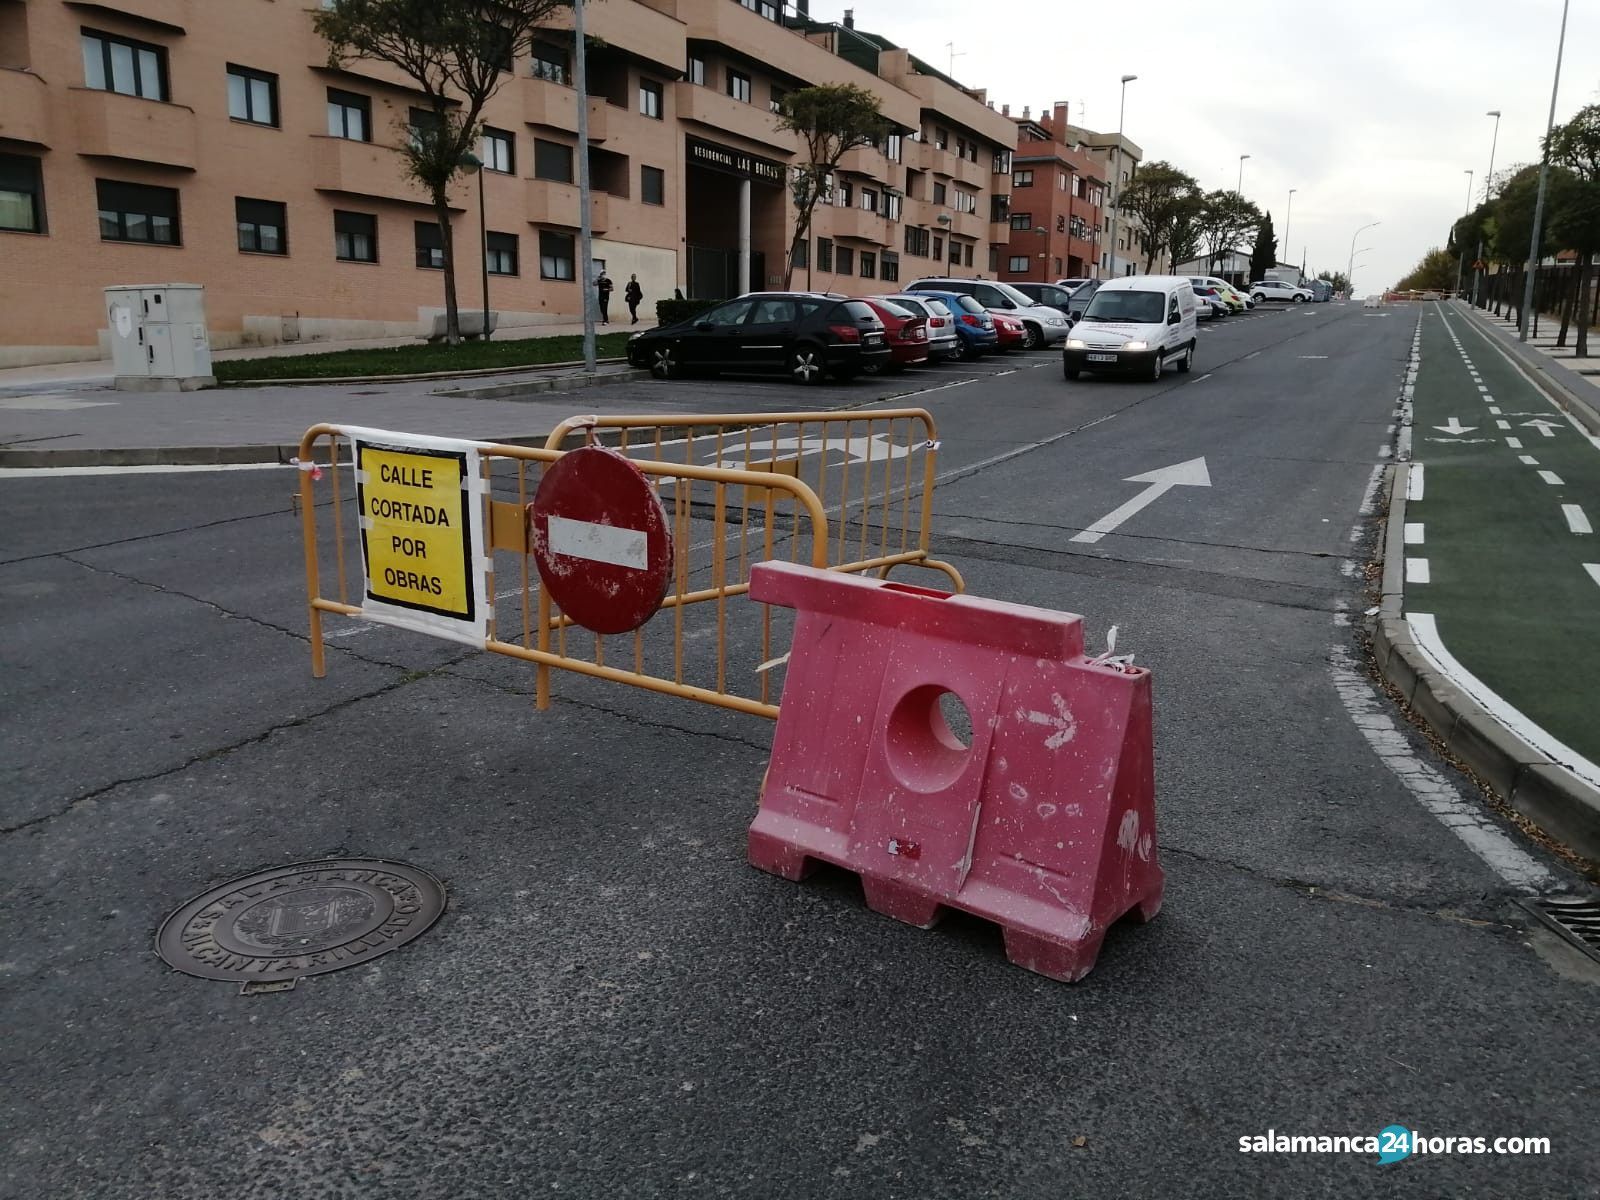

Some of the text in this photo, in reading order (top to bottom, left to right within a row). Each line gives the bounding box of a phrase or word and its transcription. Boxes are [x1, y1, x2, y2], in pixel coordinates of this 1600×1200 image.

[694, 146, 732, 166] RESIDENCIAL
[737, 157, 750, 171] LAS
[380, 464, 433, 489] CALLE
[371, 497, 450, 527] CORTADA
[392, 535, 427, 559] POR
[384, 567, 442, 595] OBRAS
[198, 871, 412, 920] SALAMANCA
